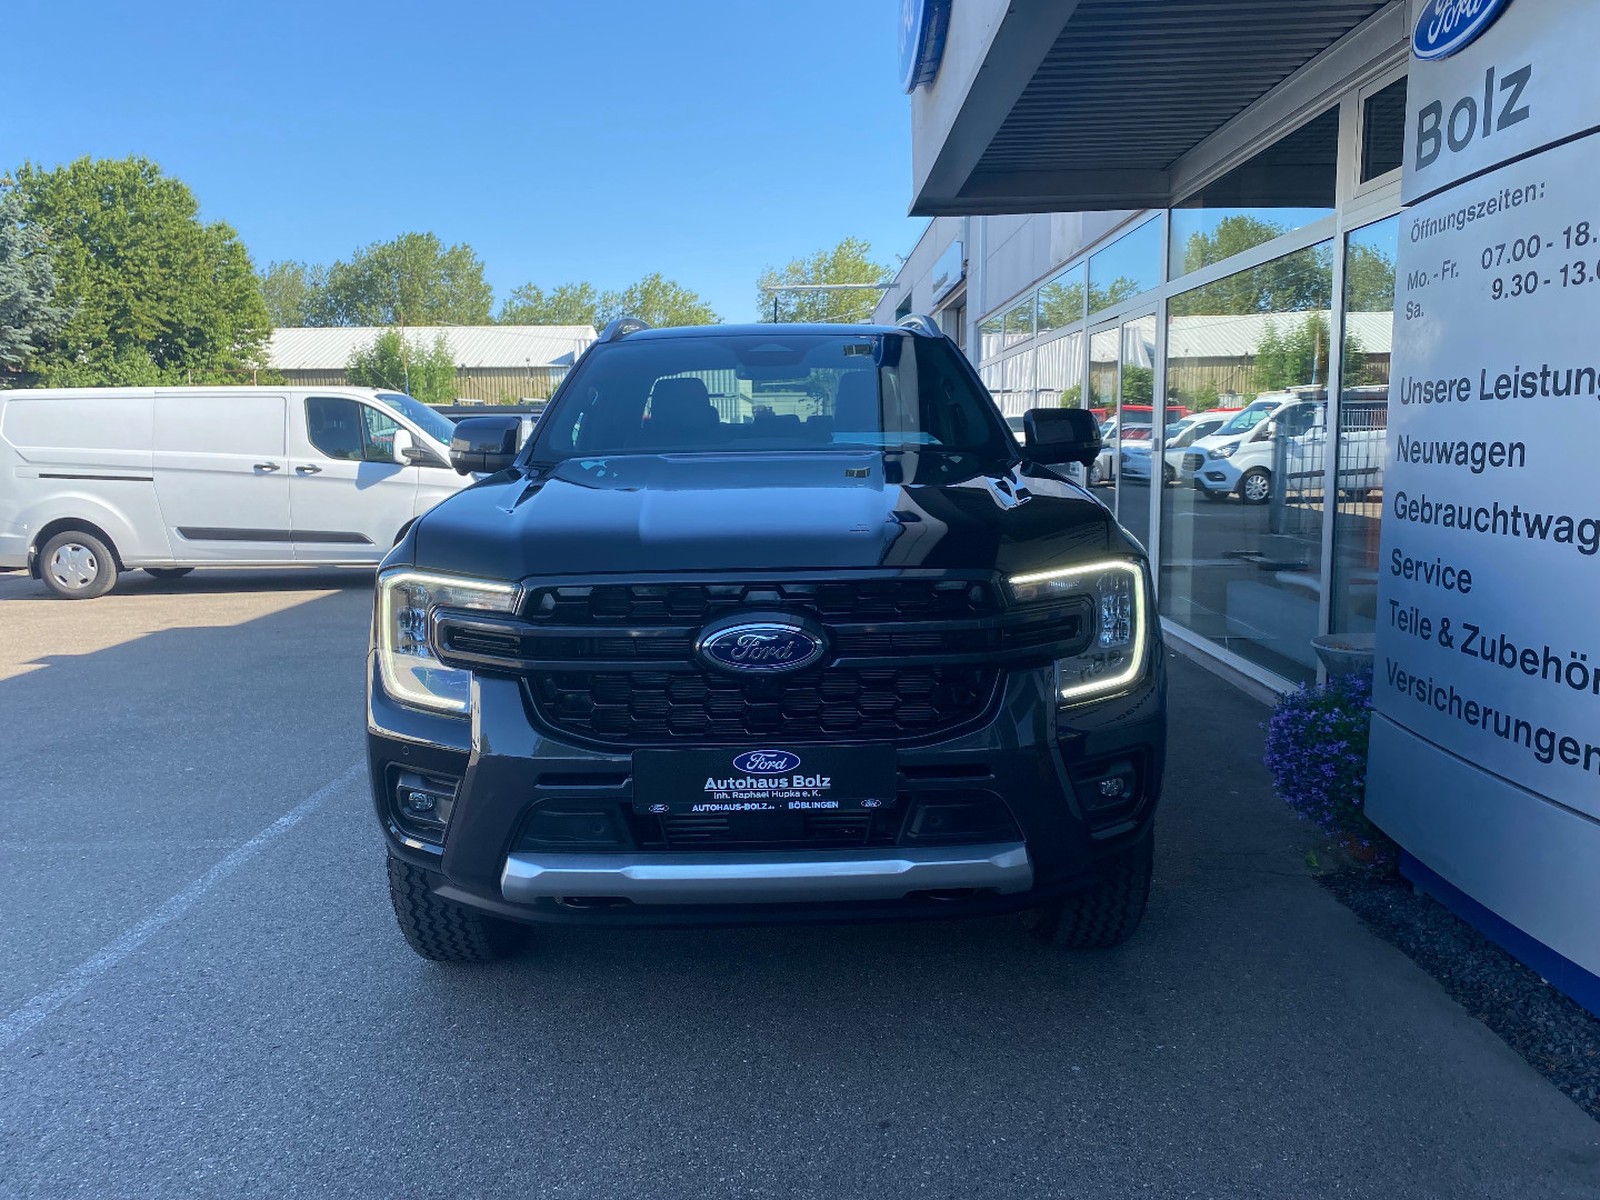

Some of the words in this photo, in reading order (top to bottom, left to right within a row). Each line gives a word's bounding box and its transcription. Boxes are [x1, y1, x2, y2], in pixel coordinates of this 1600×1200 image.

[1416, 64, 1532, 172] Bolz
[1411, 182, 1545, 243] Öffnungszeiten:
[1481, 234, 1541, 270] 07.00
[1406, 301, 1424, 320] Sa.
[1492, 271, 1539, 300] 9.30
[1559, 260, 1600, 287] 13.
[1401, 377, 1471, 405] Unsere
[1480, 364, 1600, 401] Leistun
[1397, 434, 1526, 474] Neuwagen
[1394, 491, 1600, 556] Gebrauchtwag
[1391, 548, 1472, 593] Service
[1389, 598, 1432, 640] Teile
[1438, 617, 1454, 649] &
[731, 634, 794, 660] Ford
[1386, 657, 1600, 775] Versicherungen
[704, 777, 788, 790] Autohaus
[793, 774, 831, 788] Bolz
[746, 753, 788, 770] Ford
[713, 791, 731, 800] Inh.
[732, 790, 770, 800] Raphael
[771, 790, 801, 799] Hupka
[788, 800, 839, 810] BÖBLINGEN
